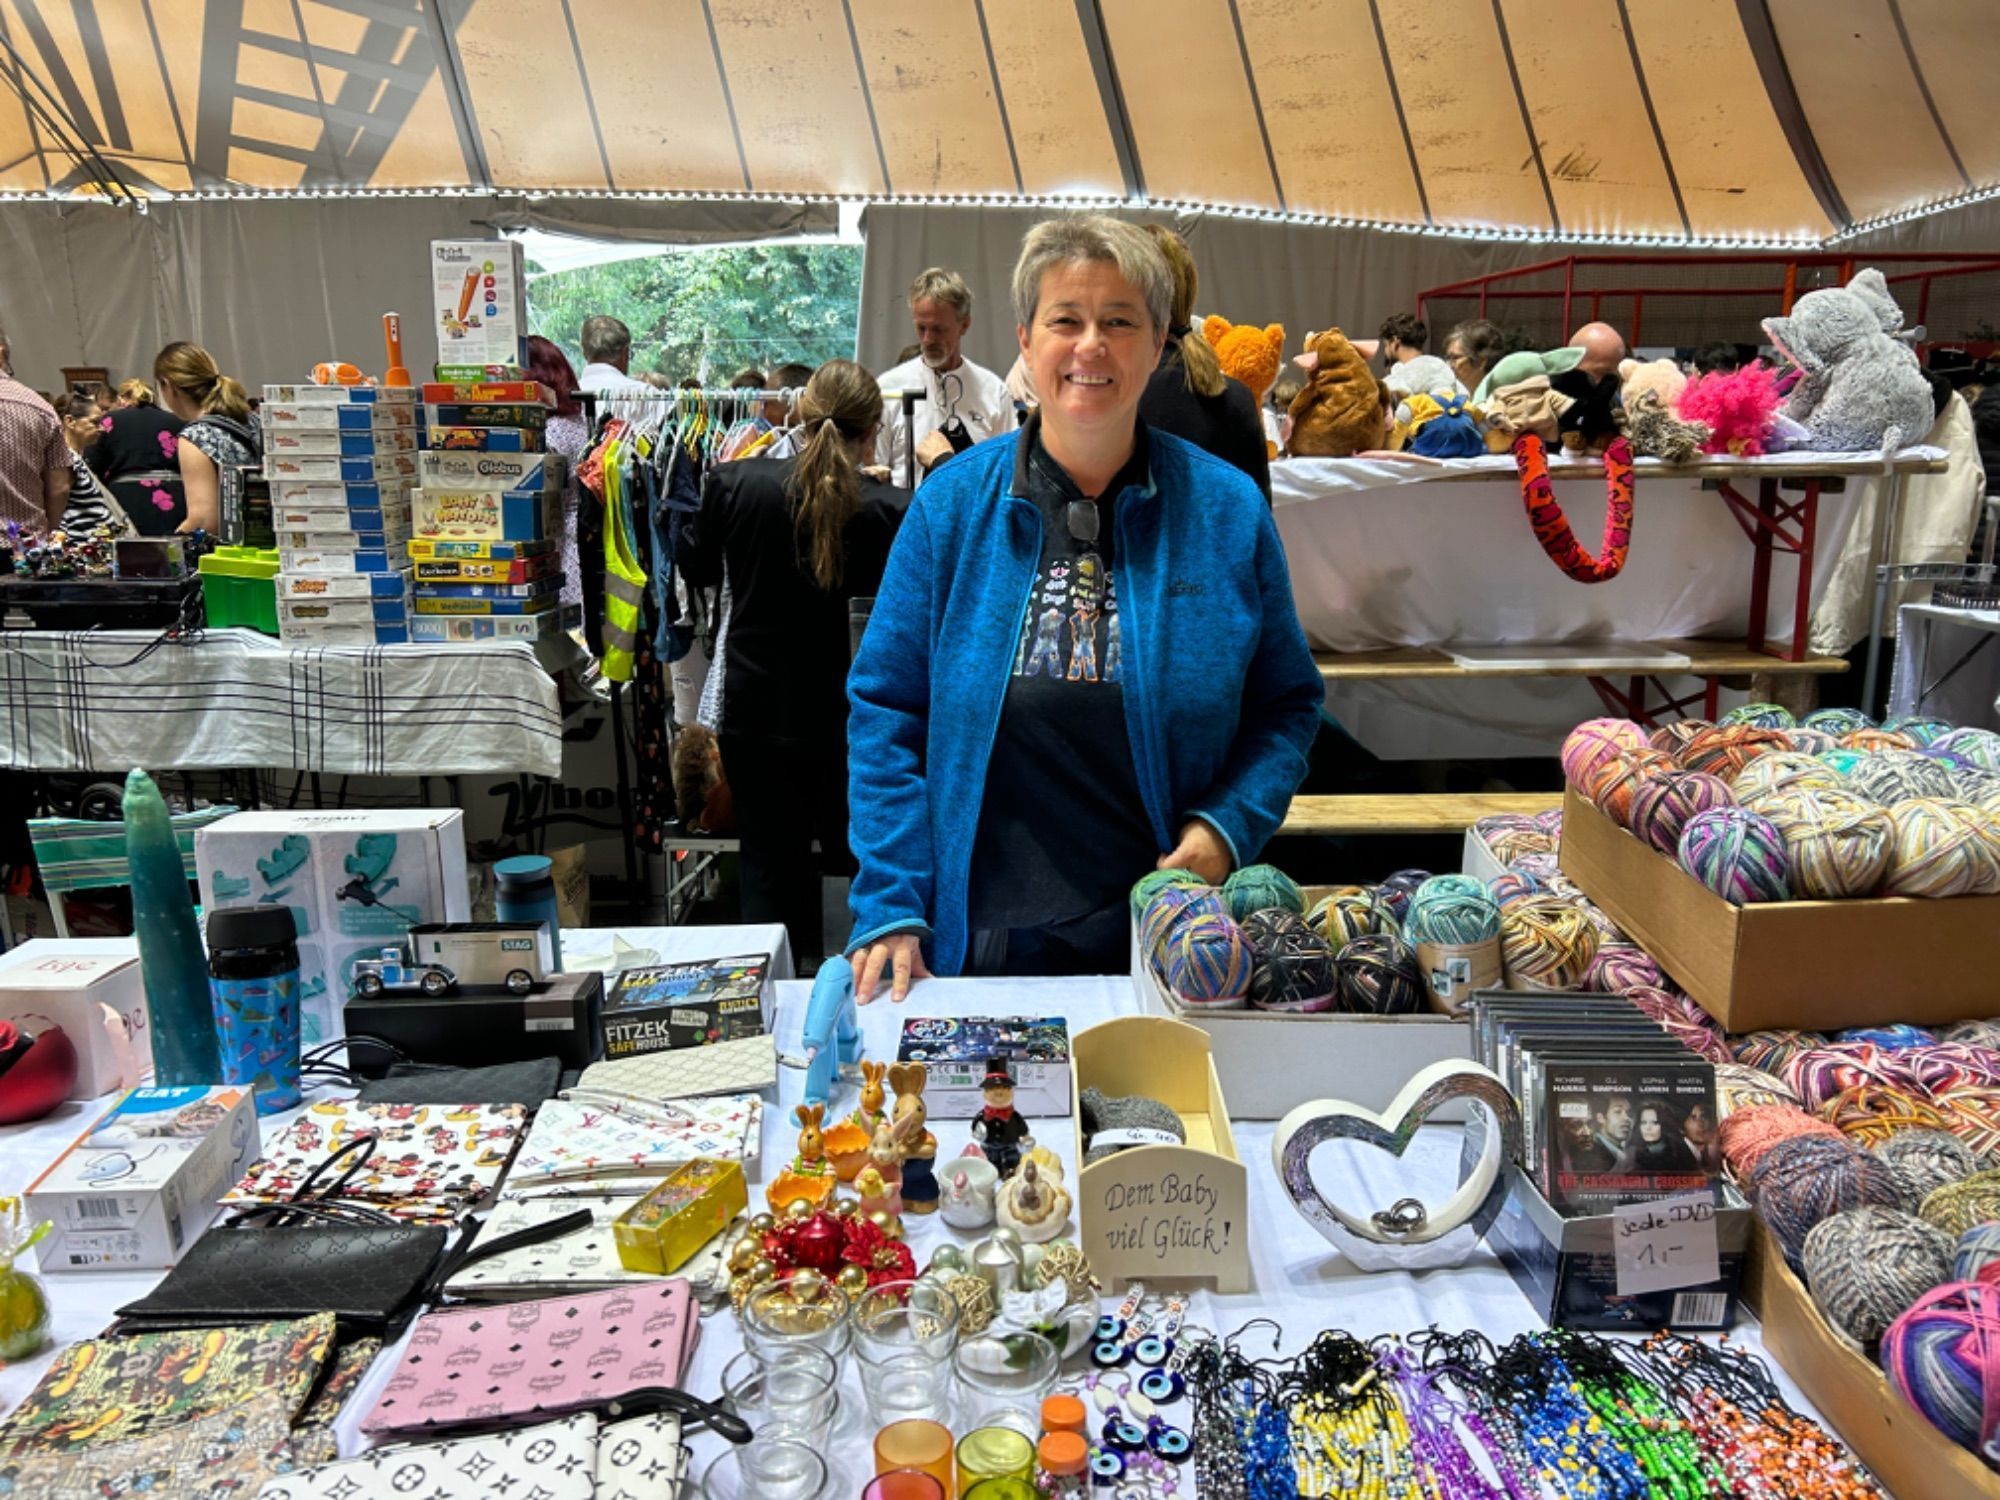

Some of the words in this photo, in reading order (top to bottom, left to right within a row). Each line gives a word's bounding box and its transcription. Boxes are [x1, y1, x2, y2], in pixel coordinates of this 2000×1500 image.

[479, 460, 521, 475] Globus
[605, 1019, 669, 1042] FITZEK
[135, 1086, 191, 1098] CAT
[1553, 1085, 1587, 1093] HARRIS
[1592, 1085, 1632, 1093] SIMPSON
[1638, 1086, 1670, 1094] LOREN
[1676, 1086, 1705, 1094] SHEEN
[1582, 1174, 1650, 1189] CASSANDRA
[1104, 1180, 1156, 1212] Dem
[1160, 1173, 1219, 1216] Baby
[1620, 1213, 1669, 1238] jede
[1669, 1201, 1716, 1223] DVD
[1105, 1215, 1149, 1251] viel
[1154, 1215, 1232, 1259] Glück!
